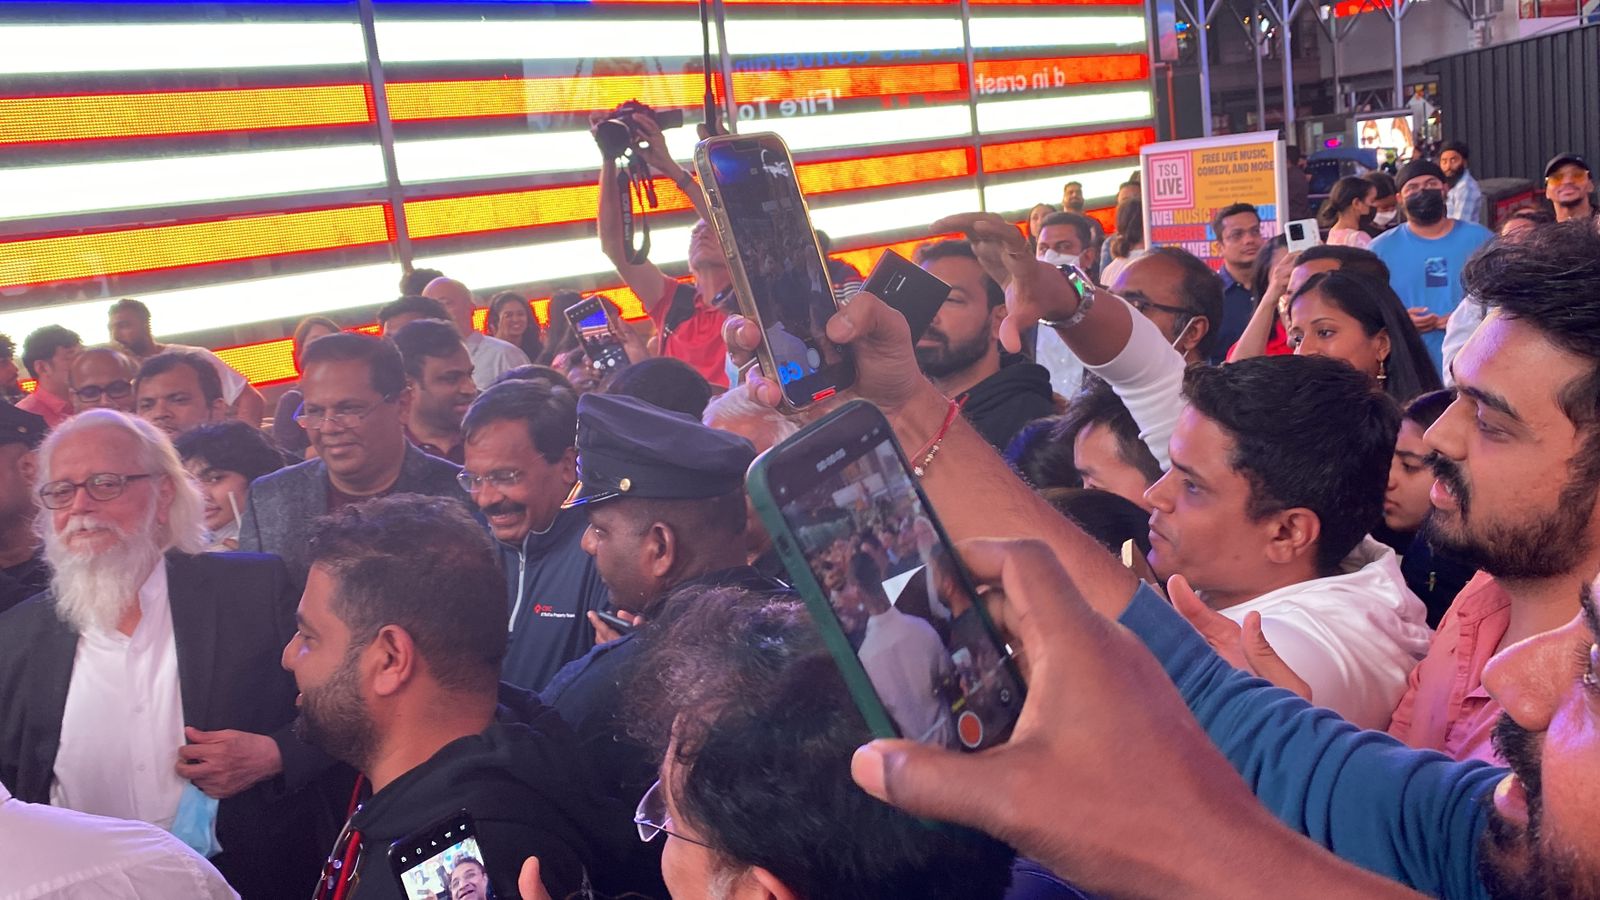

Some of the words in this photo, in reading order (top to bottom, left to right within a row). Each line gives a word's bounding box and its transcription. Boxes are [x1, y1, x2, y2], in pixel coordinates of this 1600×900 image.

[1201, 152, 1220, 164] FREE
[1221, 151, 1238, 162] LIVE
[1158, 163, 1178, 176] TSQ
[1232, 162, 1249, 174] AND
[1156, 177, 1183, 196] LIVE
[1174, 207, 1210, 225] MUSIC
